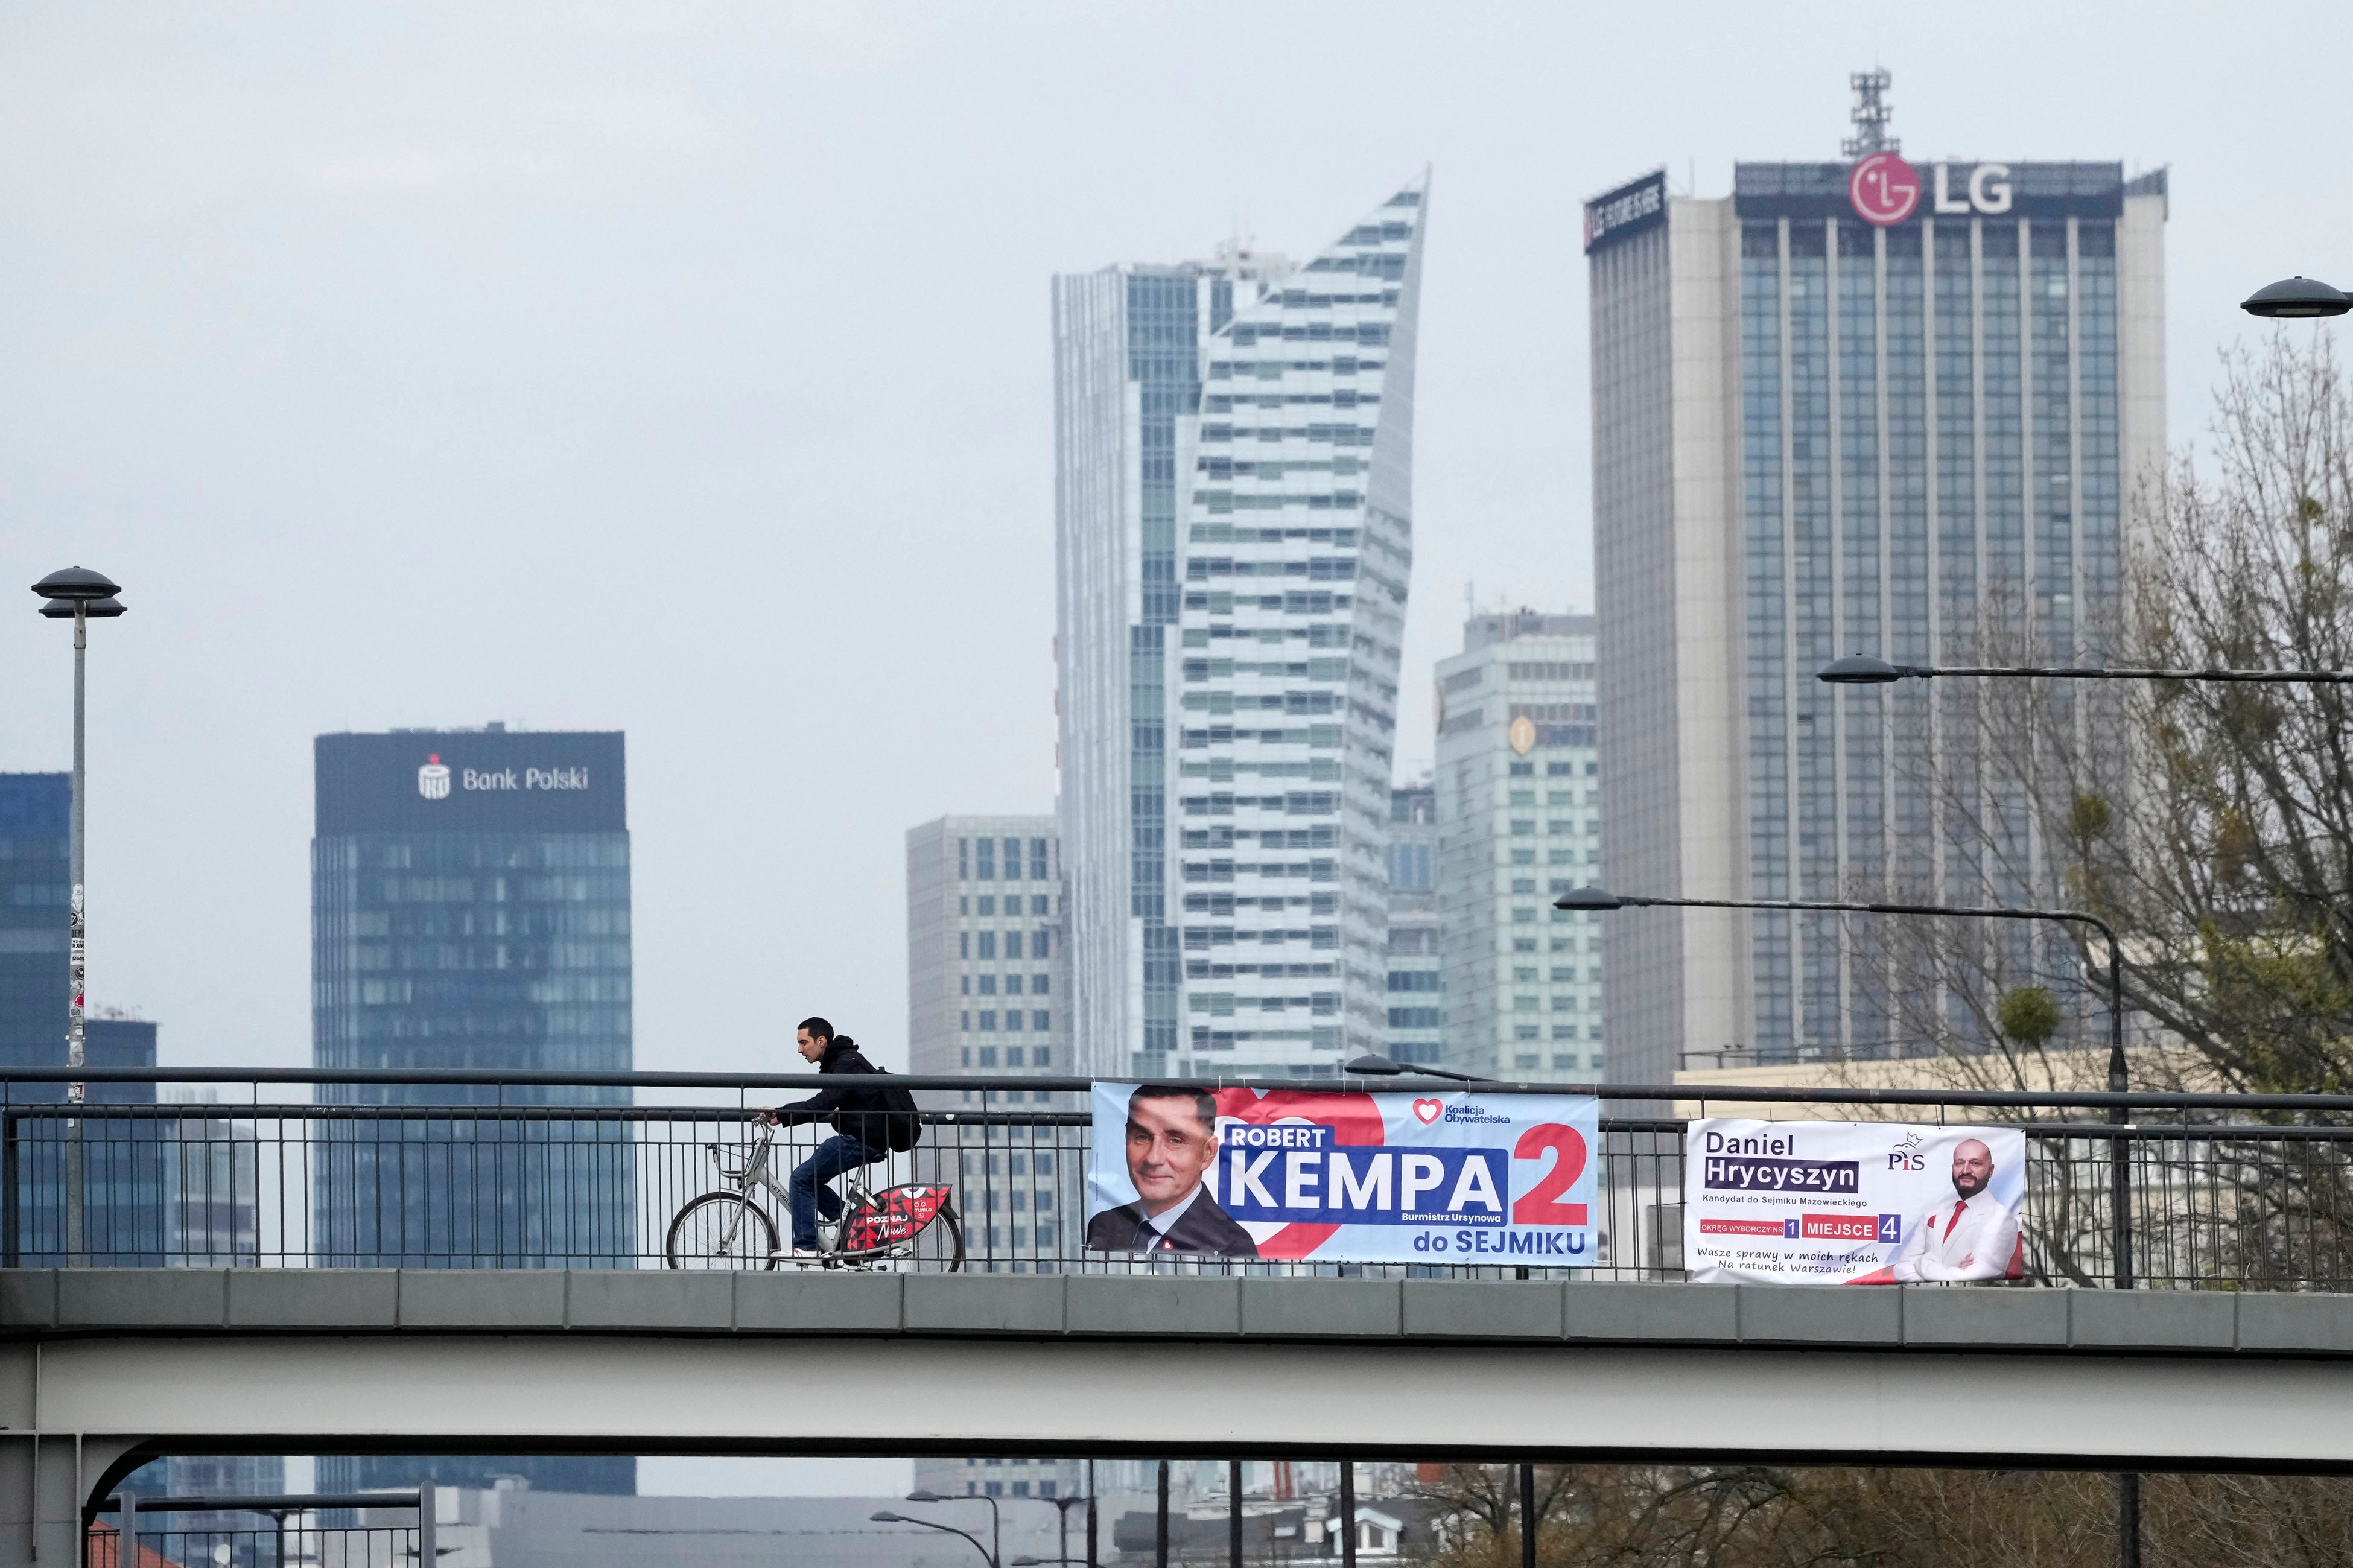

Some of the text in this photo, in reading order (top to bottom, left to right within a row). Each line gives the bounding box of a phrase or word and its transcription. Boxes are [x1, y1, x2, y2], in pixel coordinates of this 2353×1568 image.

[1934, 162, 2012, 214] LG
[463, 767, 589, 790] Bank Polski
[1445, 1114, 1510, 1125] Obywatelska
[1446, 1105, 1484, 1116] Koalicja
[1231, 1128, 1326, 1147] ROBERT
[1706, 1132, 1793, 1155] Daniel
[1887, 1153, 1925, 1170] PiS
[1230, 1149, 1503, 1212] KEMPA
[1513, 1123, 1587, 1226] 2
[1707, 1159, 1855, 1191] Hrycyszyn
[1703, 1195, 1744, 1204] Kandydat
[1761, 1197, 1797, 1205] Sejmiku
[1800, 1198, 1867, 1208] Mazowieckiego
[866, 1214, 908, 1224] POZNAJ
[1402, 1212, 1501, 1224] Burmistrz Ursynowa
[1701, 1224, 1727, 1233] OKRĘG
[1788, 1221, 1795, 1236] 1
[1807, 1216, 1897, 1240] MIEJSCE 4
[1413, 1230, 1586, 1254] do SEJMIKU
[1697, 1248, 1731, 1257] Wasze
[1736, 1251, 1778, 1262] sprawy
[1799, 1251, 1834, 1262] moich
[1839, 1252, 1878, 1264] rękach
[1739, 1262, 1785, 1272] ratunek
[1790, 1263, 1856, 1274] Warszawie!
